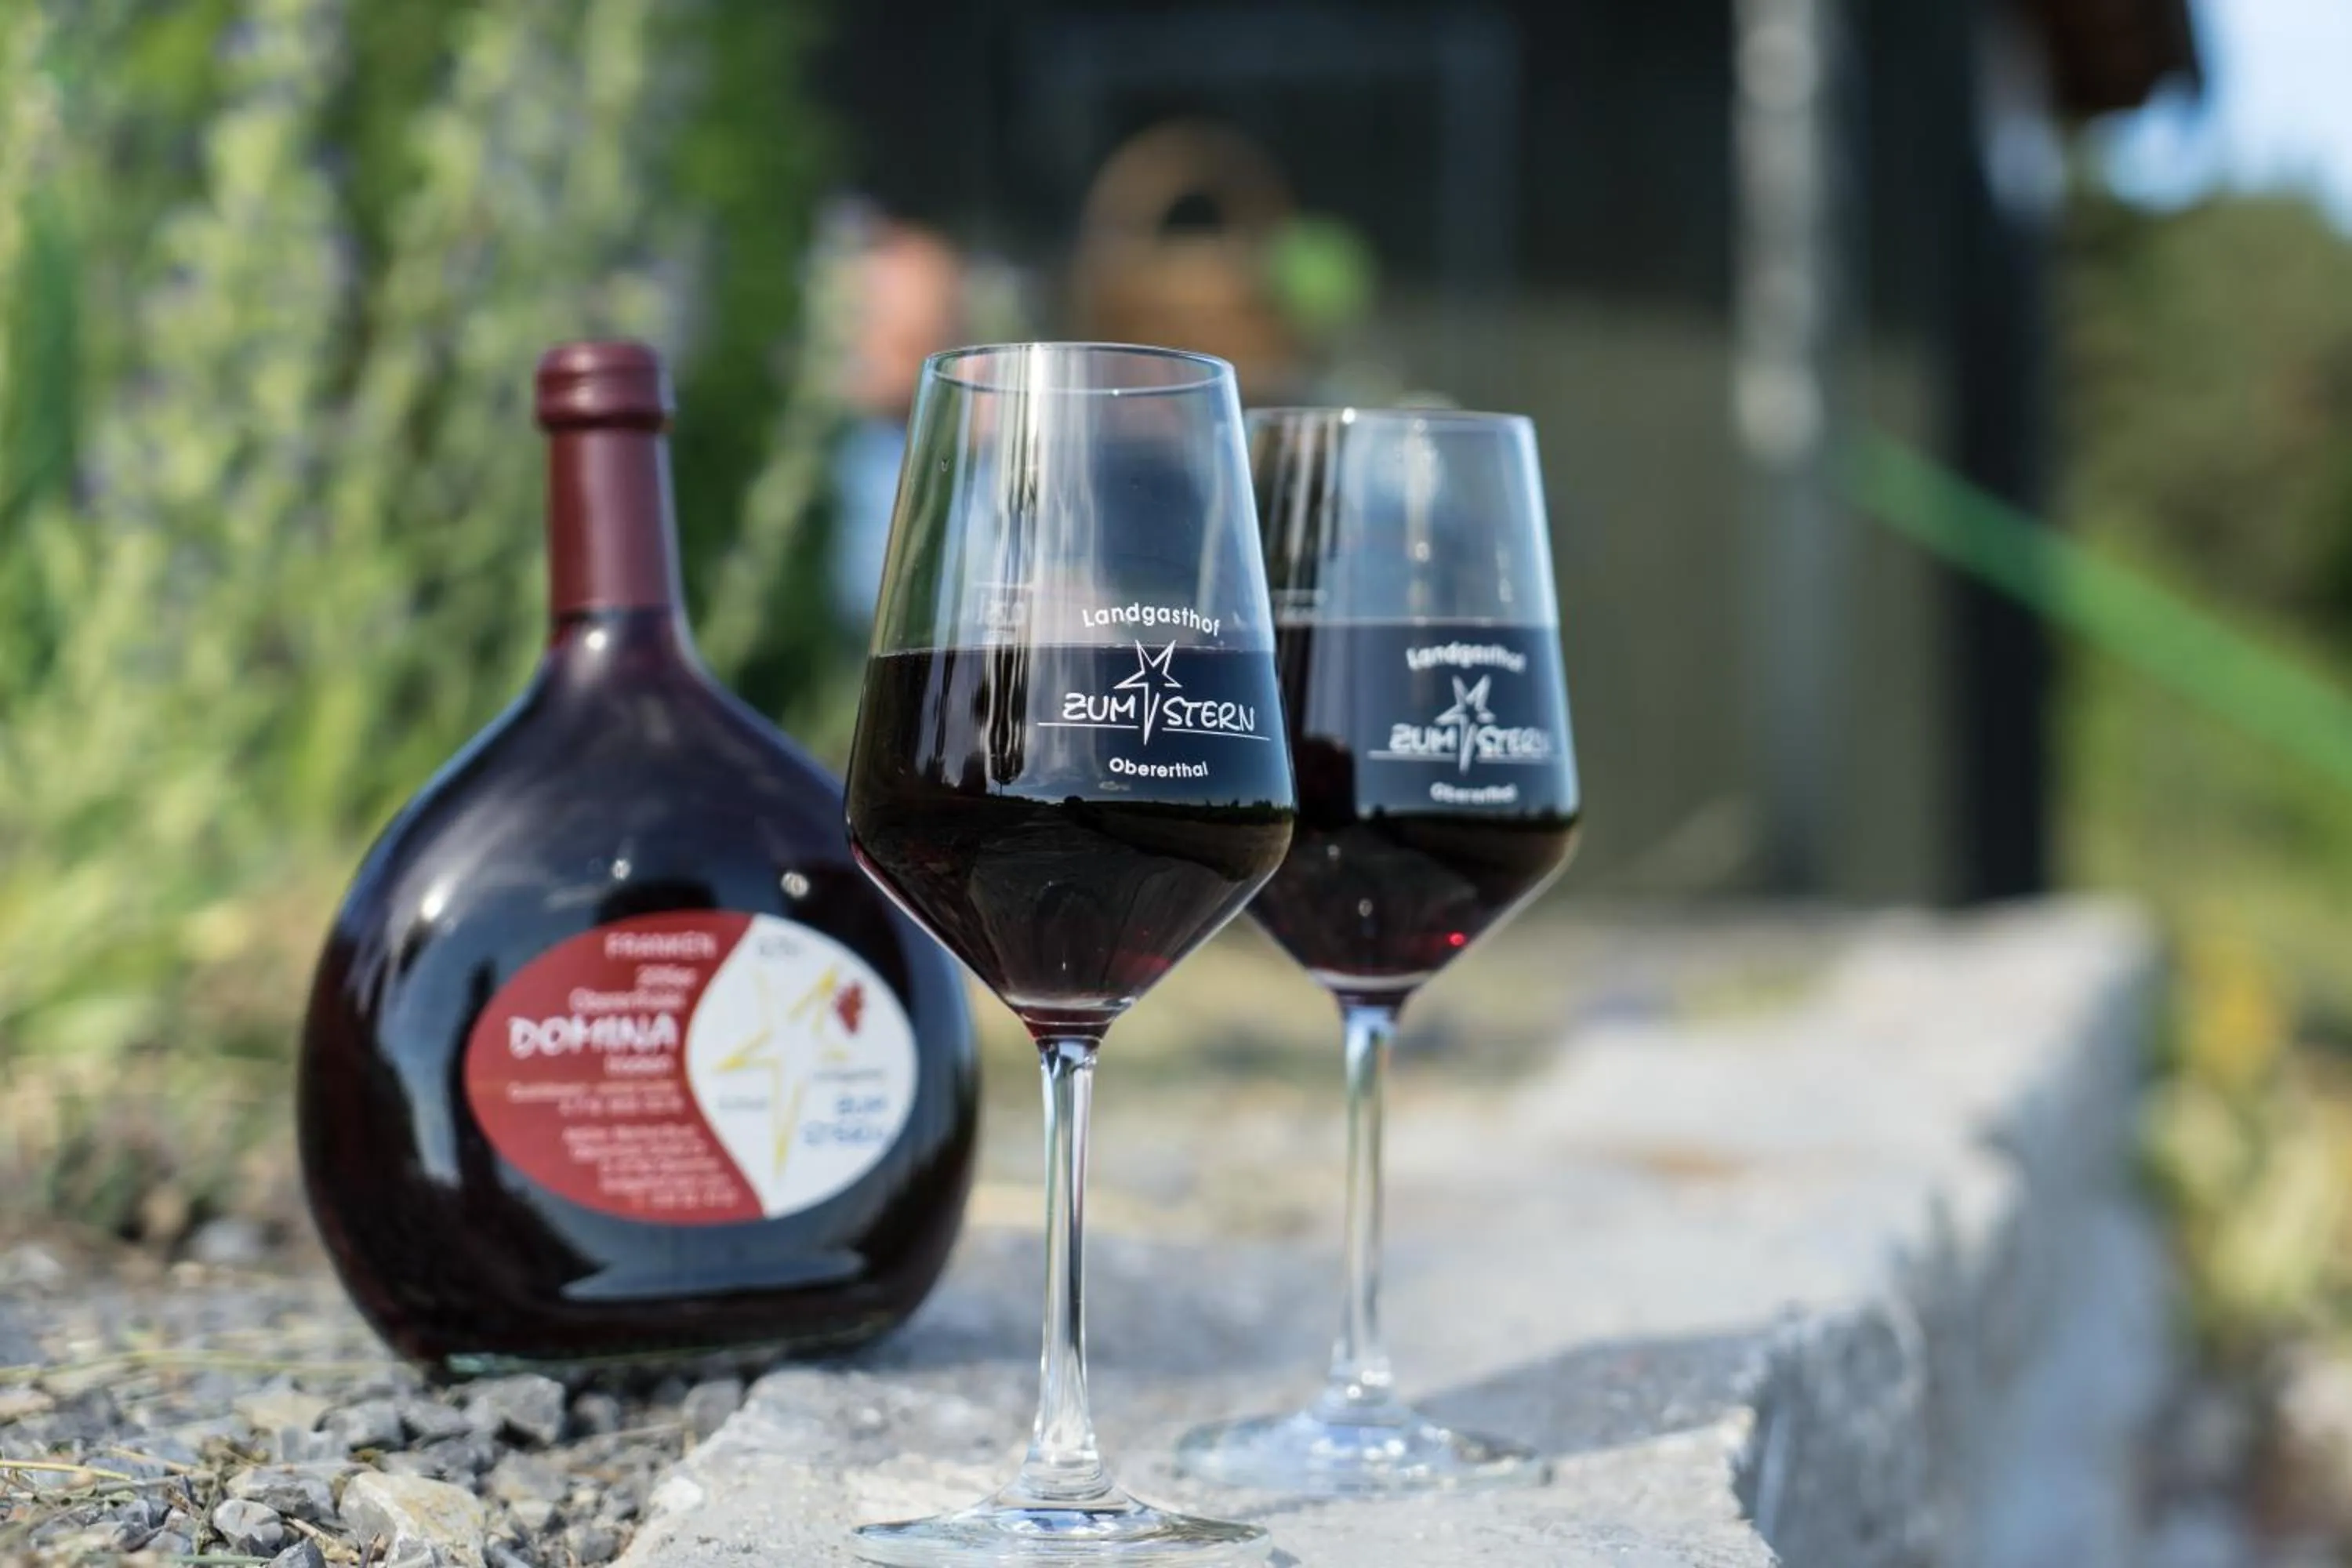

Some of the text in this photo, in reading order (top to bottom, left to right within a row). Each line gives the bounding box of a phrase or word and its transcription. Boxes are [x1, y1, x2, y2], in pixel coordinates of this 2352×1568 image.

[1082, 602, 1221, 637] Landgasthof
[1062, 692, 1255, 732] ZUM STERN
[1389, 723, 1457, 753] ZUM
[1109, 757, 1209, 778] Obererthal
[508, 1011, 680, 1058] DOMINA
